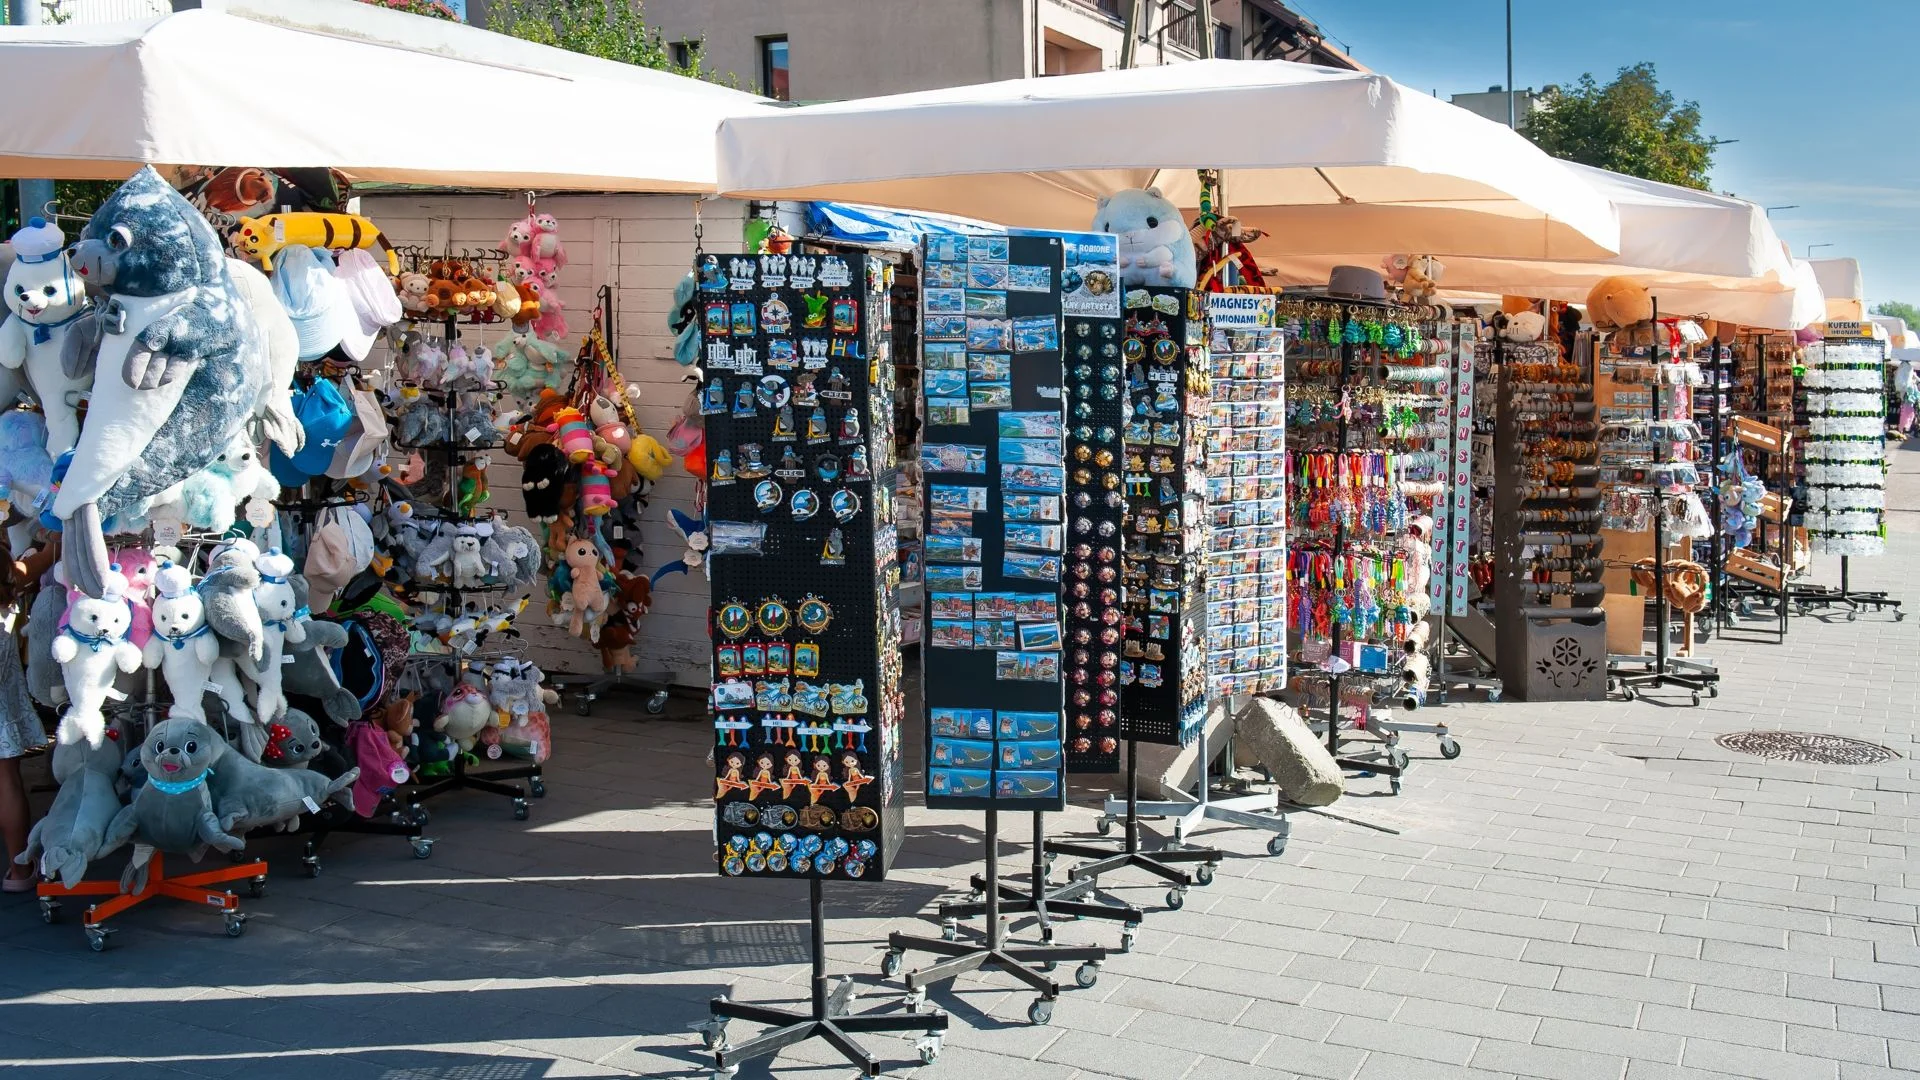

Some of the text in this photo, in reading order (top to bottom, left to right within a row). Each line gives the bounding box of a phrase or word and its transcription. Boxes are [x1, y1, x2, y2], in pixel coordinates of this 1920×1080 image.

[1079, 244, 1111, 253] ROBIONE
[1211, 297, 1260, 310] MAGNESY
[1215, 314, 1256, 324] IMIONAMI
[767, 325, 785, 333] HEL
[708, 343, 734, 361] HEL
[735, 349, 761, 366] HEL
[1149, 373, 1177, 382] HEL
[1455, 359, 1471, 599] BRANSOLETKI
